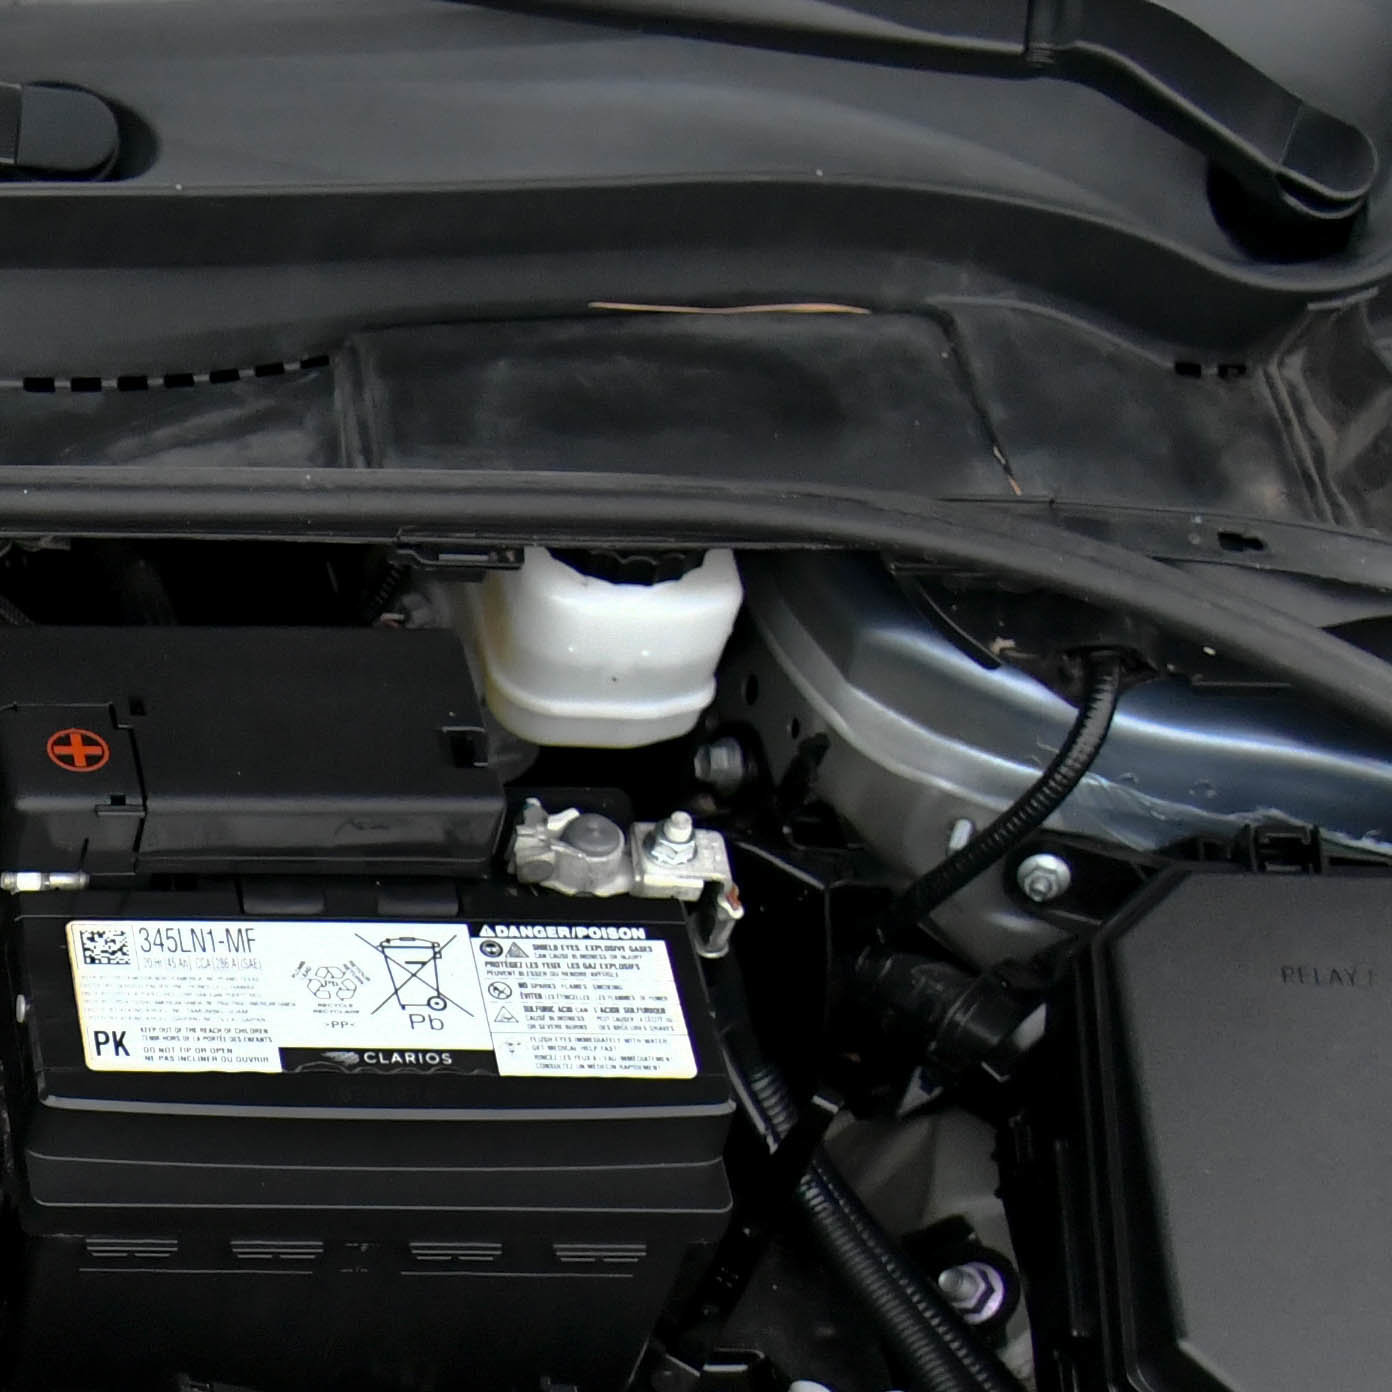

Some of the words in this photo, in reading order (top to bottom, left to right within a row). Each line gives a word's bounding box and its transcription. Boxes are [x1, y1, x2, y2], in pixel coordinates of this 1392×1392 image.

[139, 927, 256, 953] 345LN1-MF
[495, 926, 646, 940] DANGER/POISON
[408, 1014, 444, 1031] Pb
[93, 1031, 131, 1057] PK
[363, 1052, 453, 1065] CLARIOS
